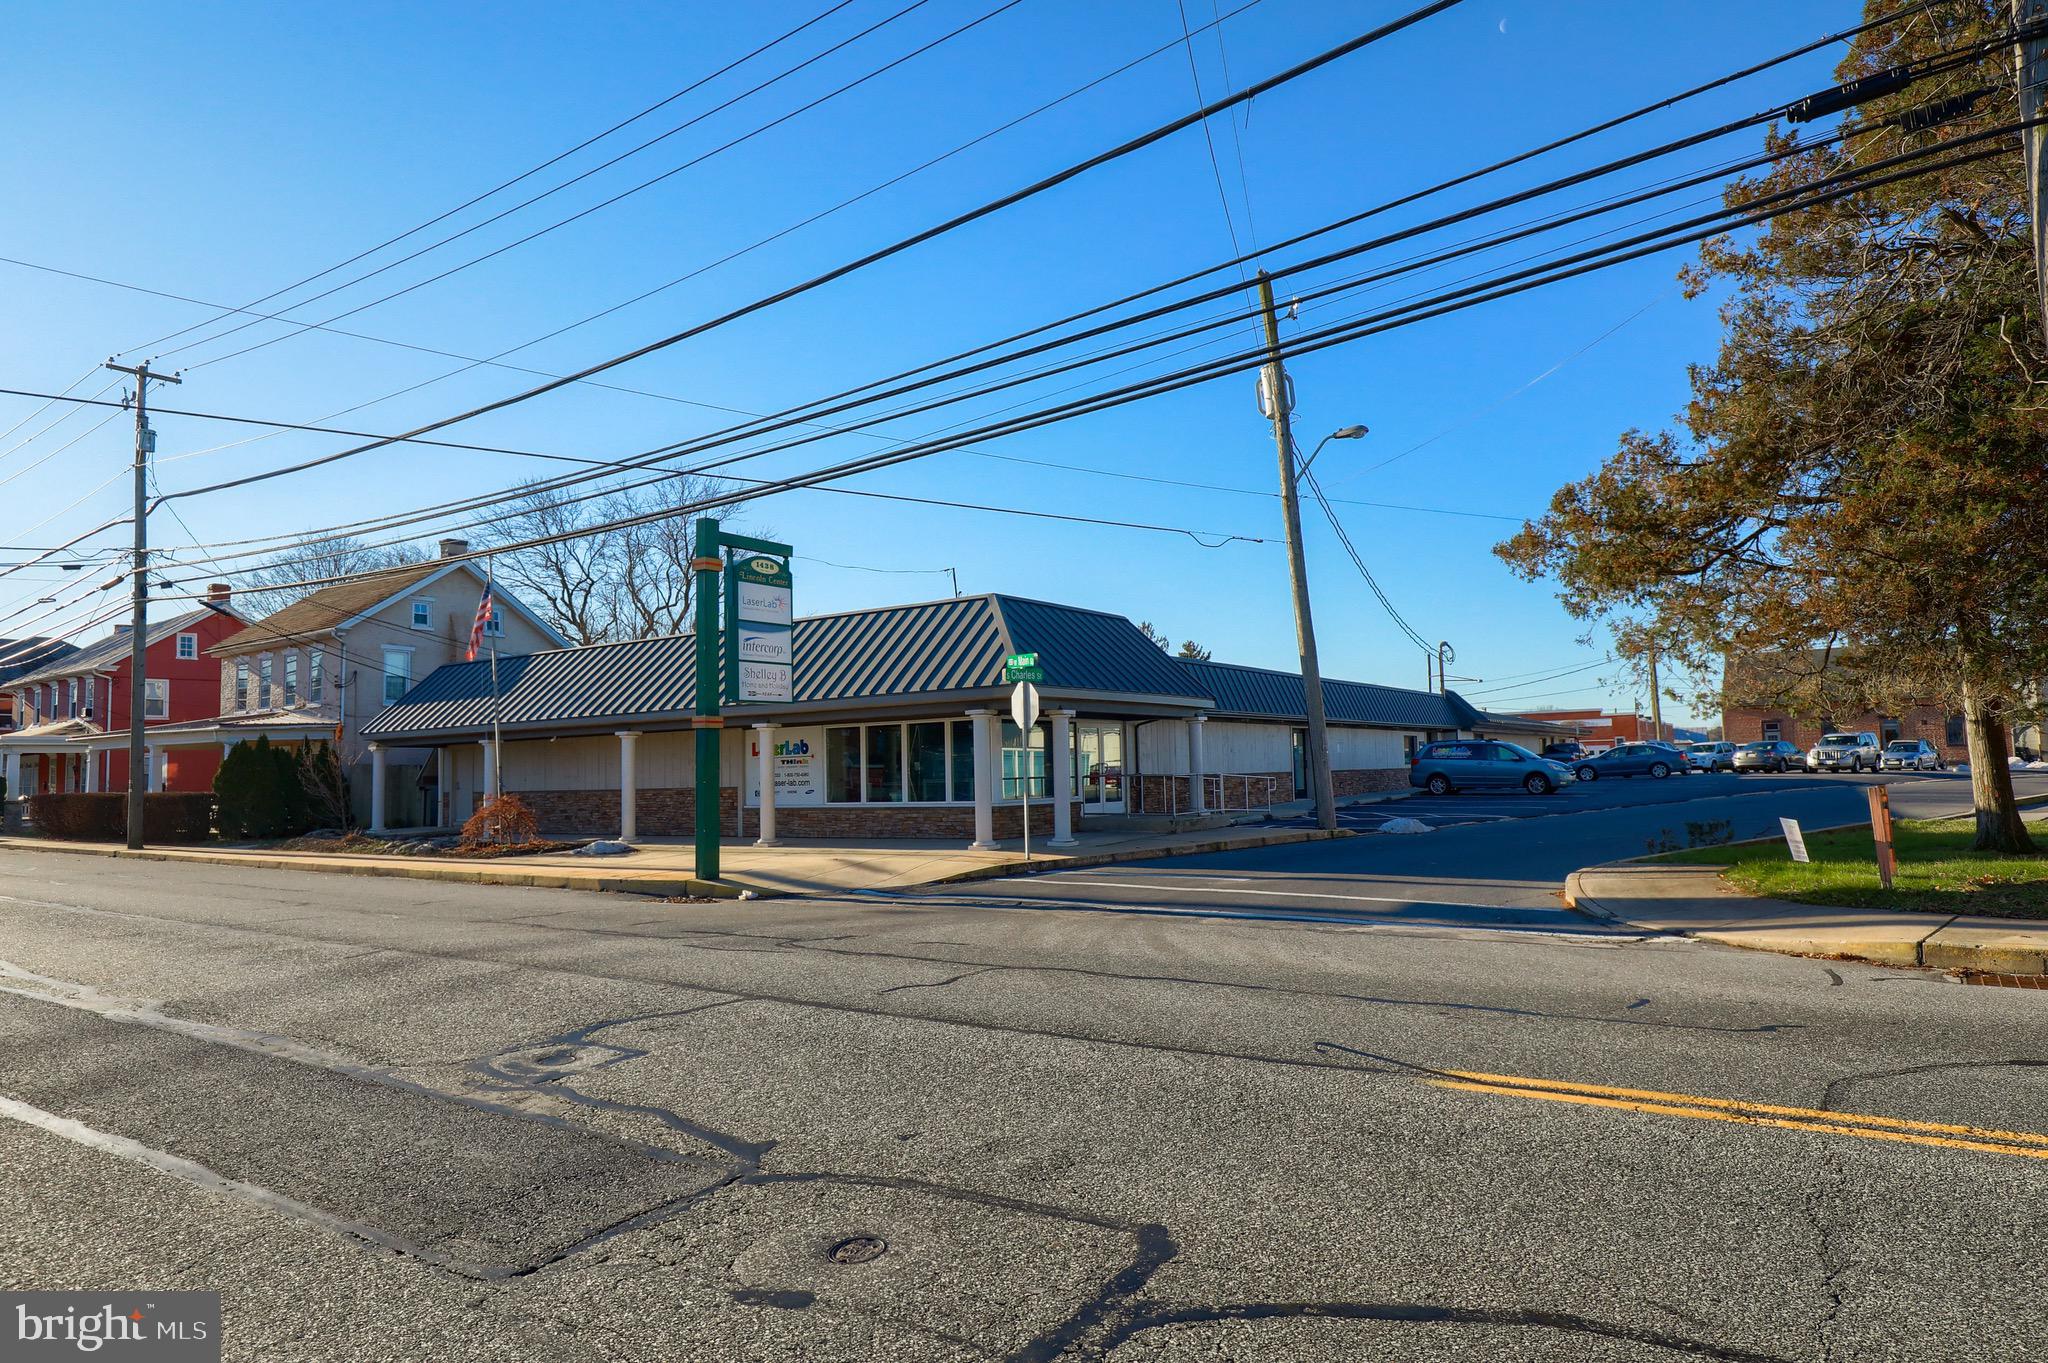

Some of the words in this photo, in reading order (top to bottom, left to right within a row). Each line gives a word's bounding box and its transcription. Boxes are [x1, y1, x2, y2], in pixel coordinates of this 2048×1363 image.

[768, 575, 789, 586] Center
[742, 595, 777, 608] LaserLab
[742, 640, 783, 656] intercorp
[744, 666, 777, 682] Shelley
[780, 669, 787, 681] B
[1011, 670, 1035, 681] Charles
[752, 739, 809, 756] LerLab
